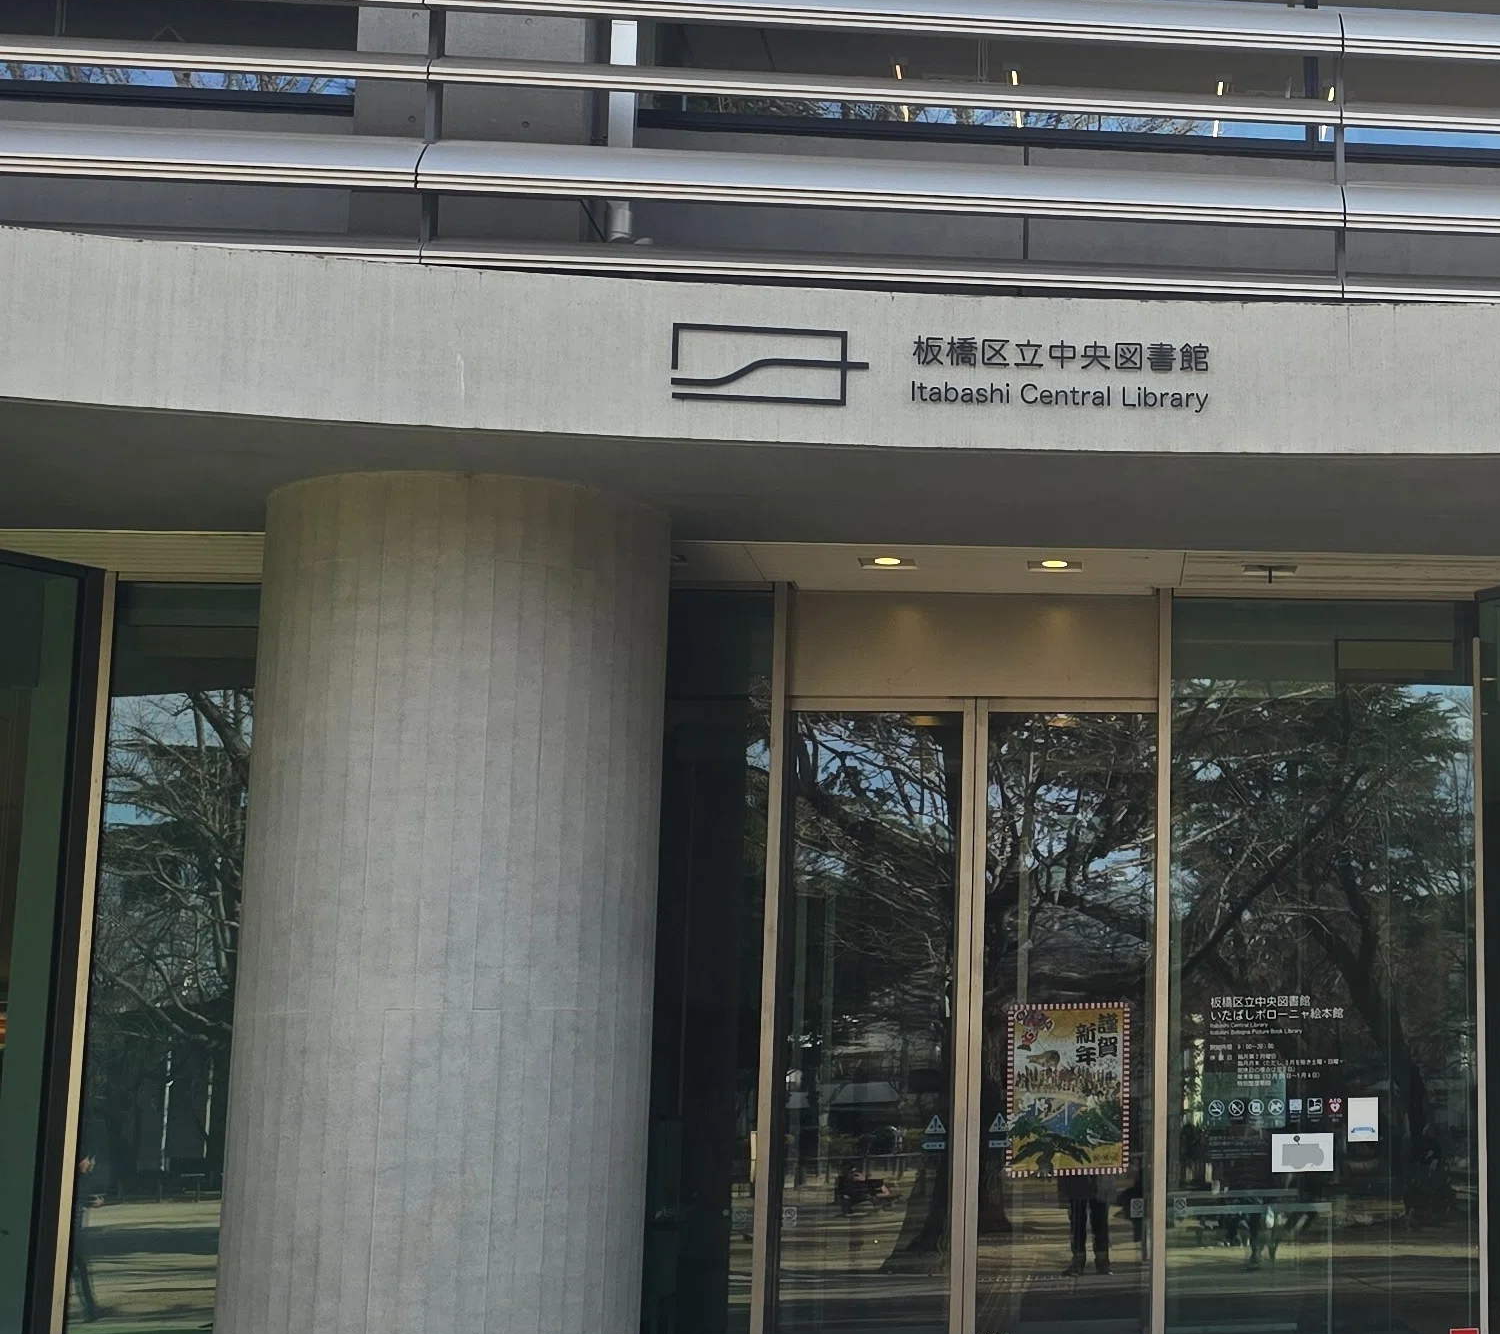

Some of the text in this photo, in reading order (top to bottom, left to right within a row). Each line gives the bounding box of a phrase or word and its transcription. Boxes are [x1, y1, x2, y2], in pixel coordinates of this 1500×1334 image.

[912, 335, 1210, 373] 板橋区立中央図書館
[910, 380, 1209, 413] Itabashi Central Library
[1210, 995, 1311, 1008] 板橋区立中央図書館
[1210, 1007, 1344, 1021] いたばしボローニャ絵本館
[1075, 1022, 1096, 1066] 新年
